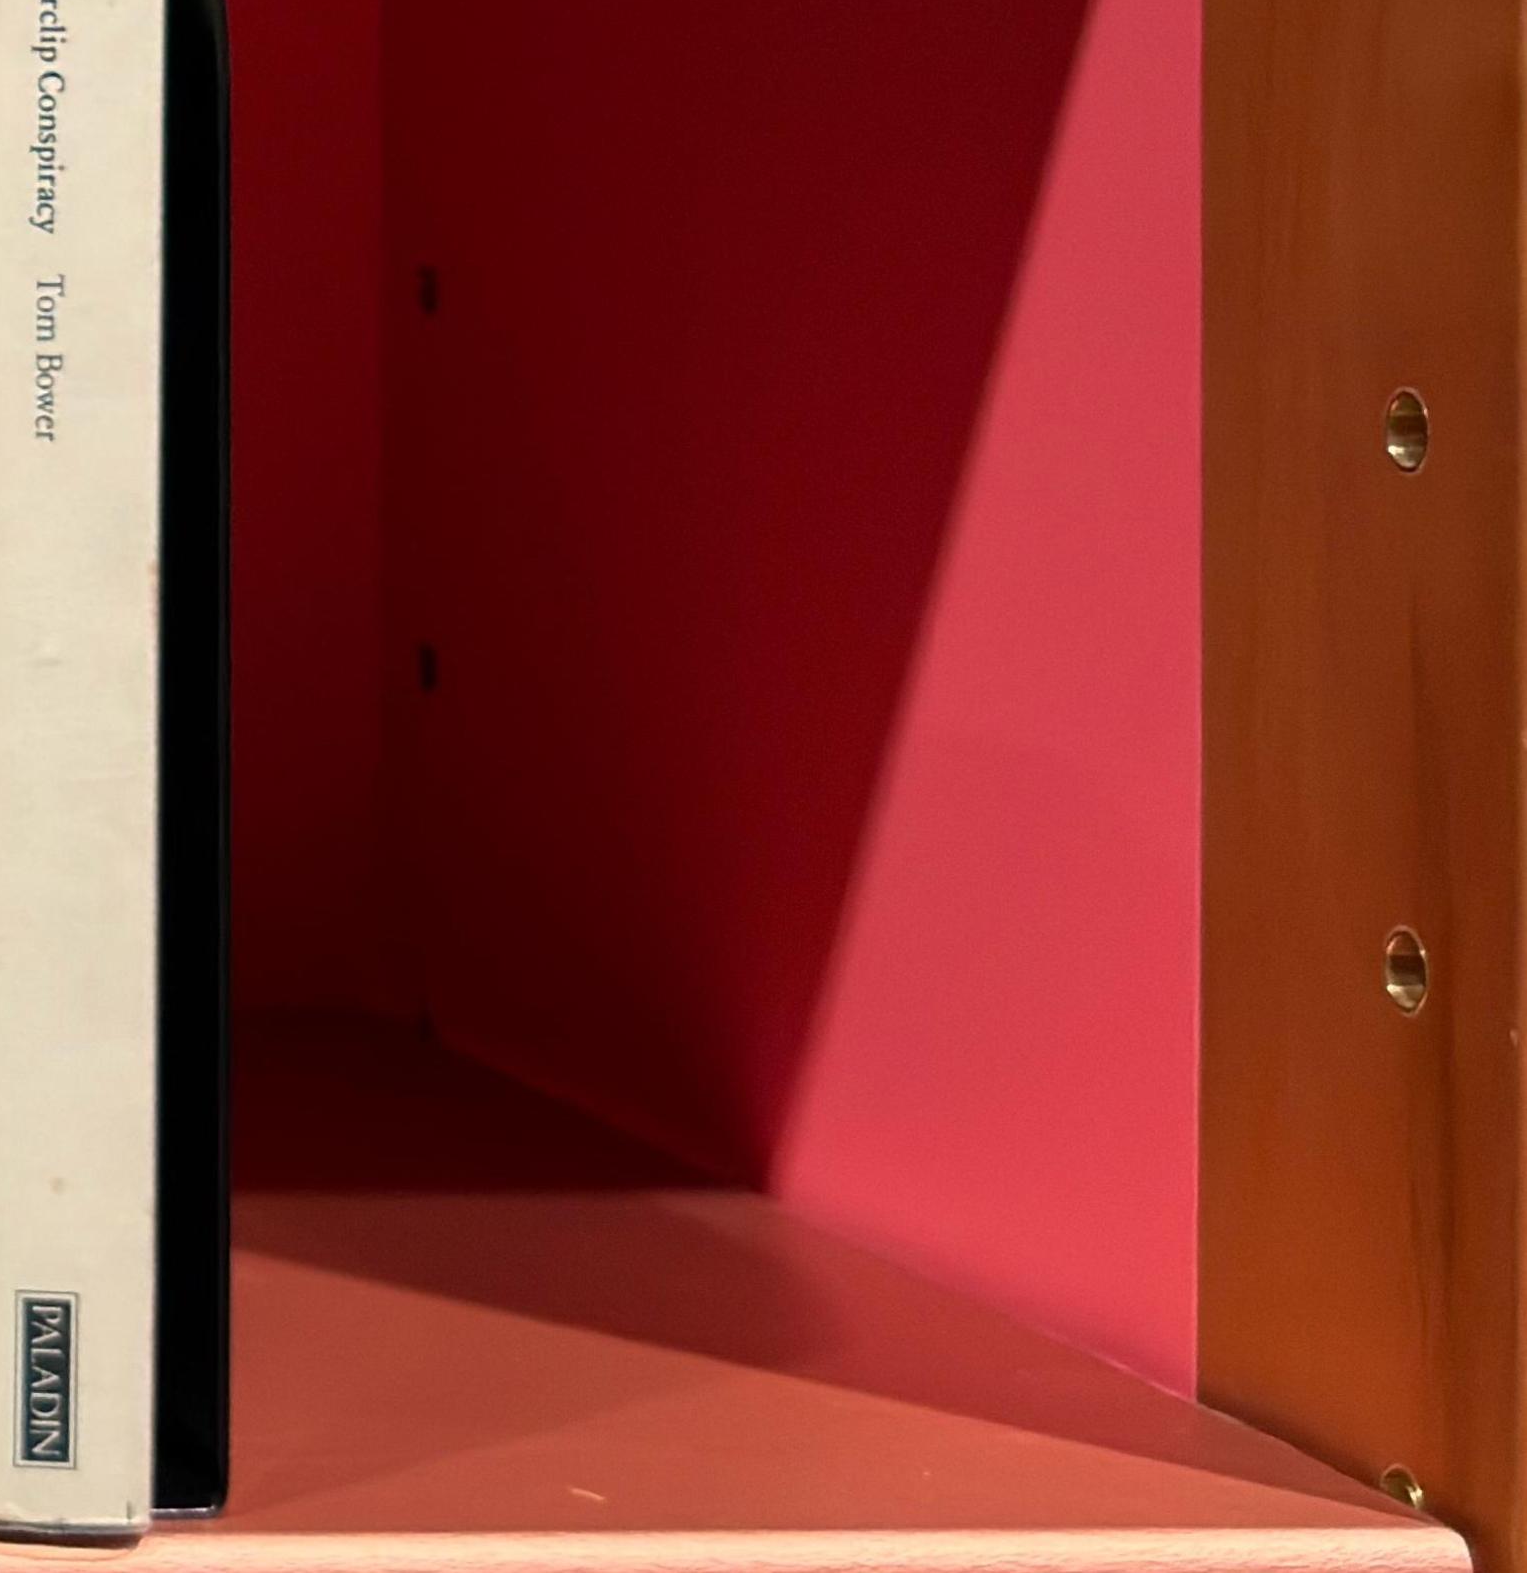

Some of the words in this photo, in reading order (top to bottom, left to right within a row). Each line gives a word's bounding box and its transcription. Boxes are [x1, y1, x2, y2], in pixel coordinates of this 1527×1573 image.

[28, 70, 66, 234] Conspiracy
[36, 275, 66, 343] Tom
[35, 353, 65, 441] Bower
[31, 1305, 62, 1457] PALADIN
